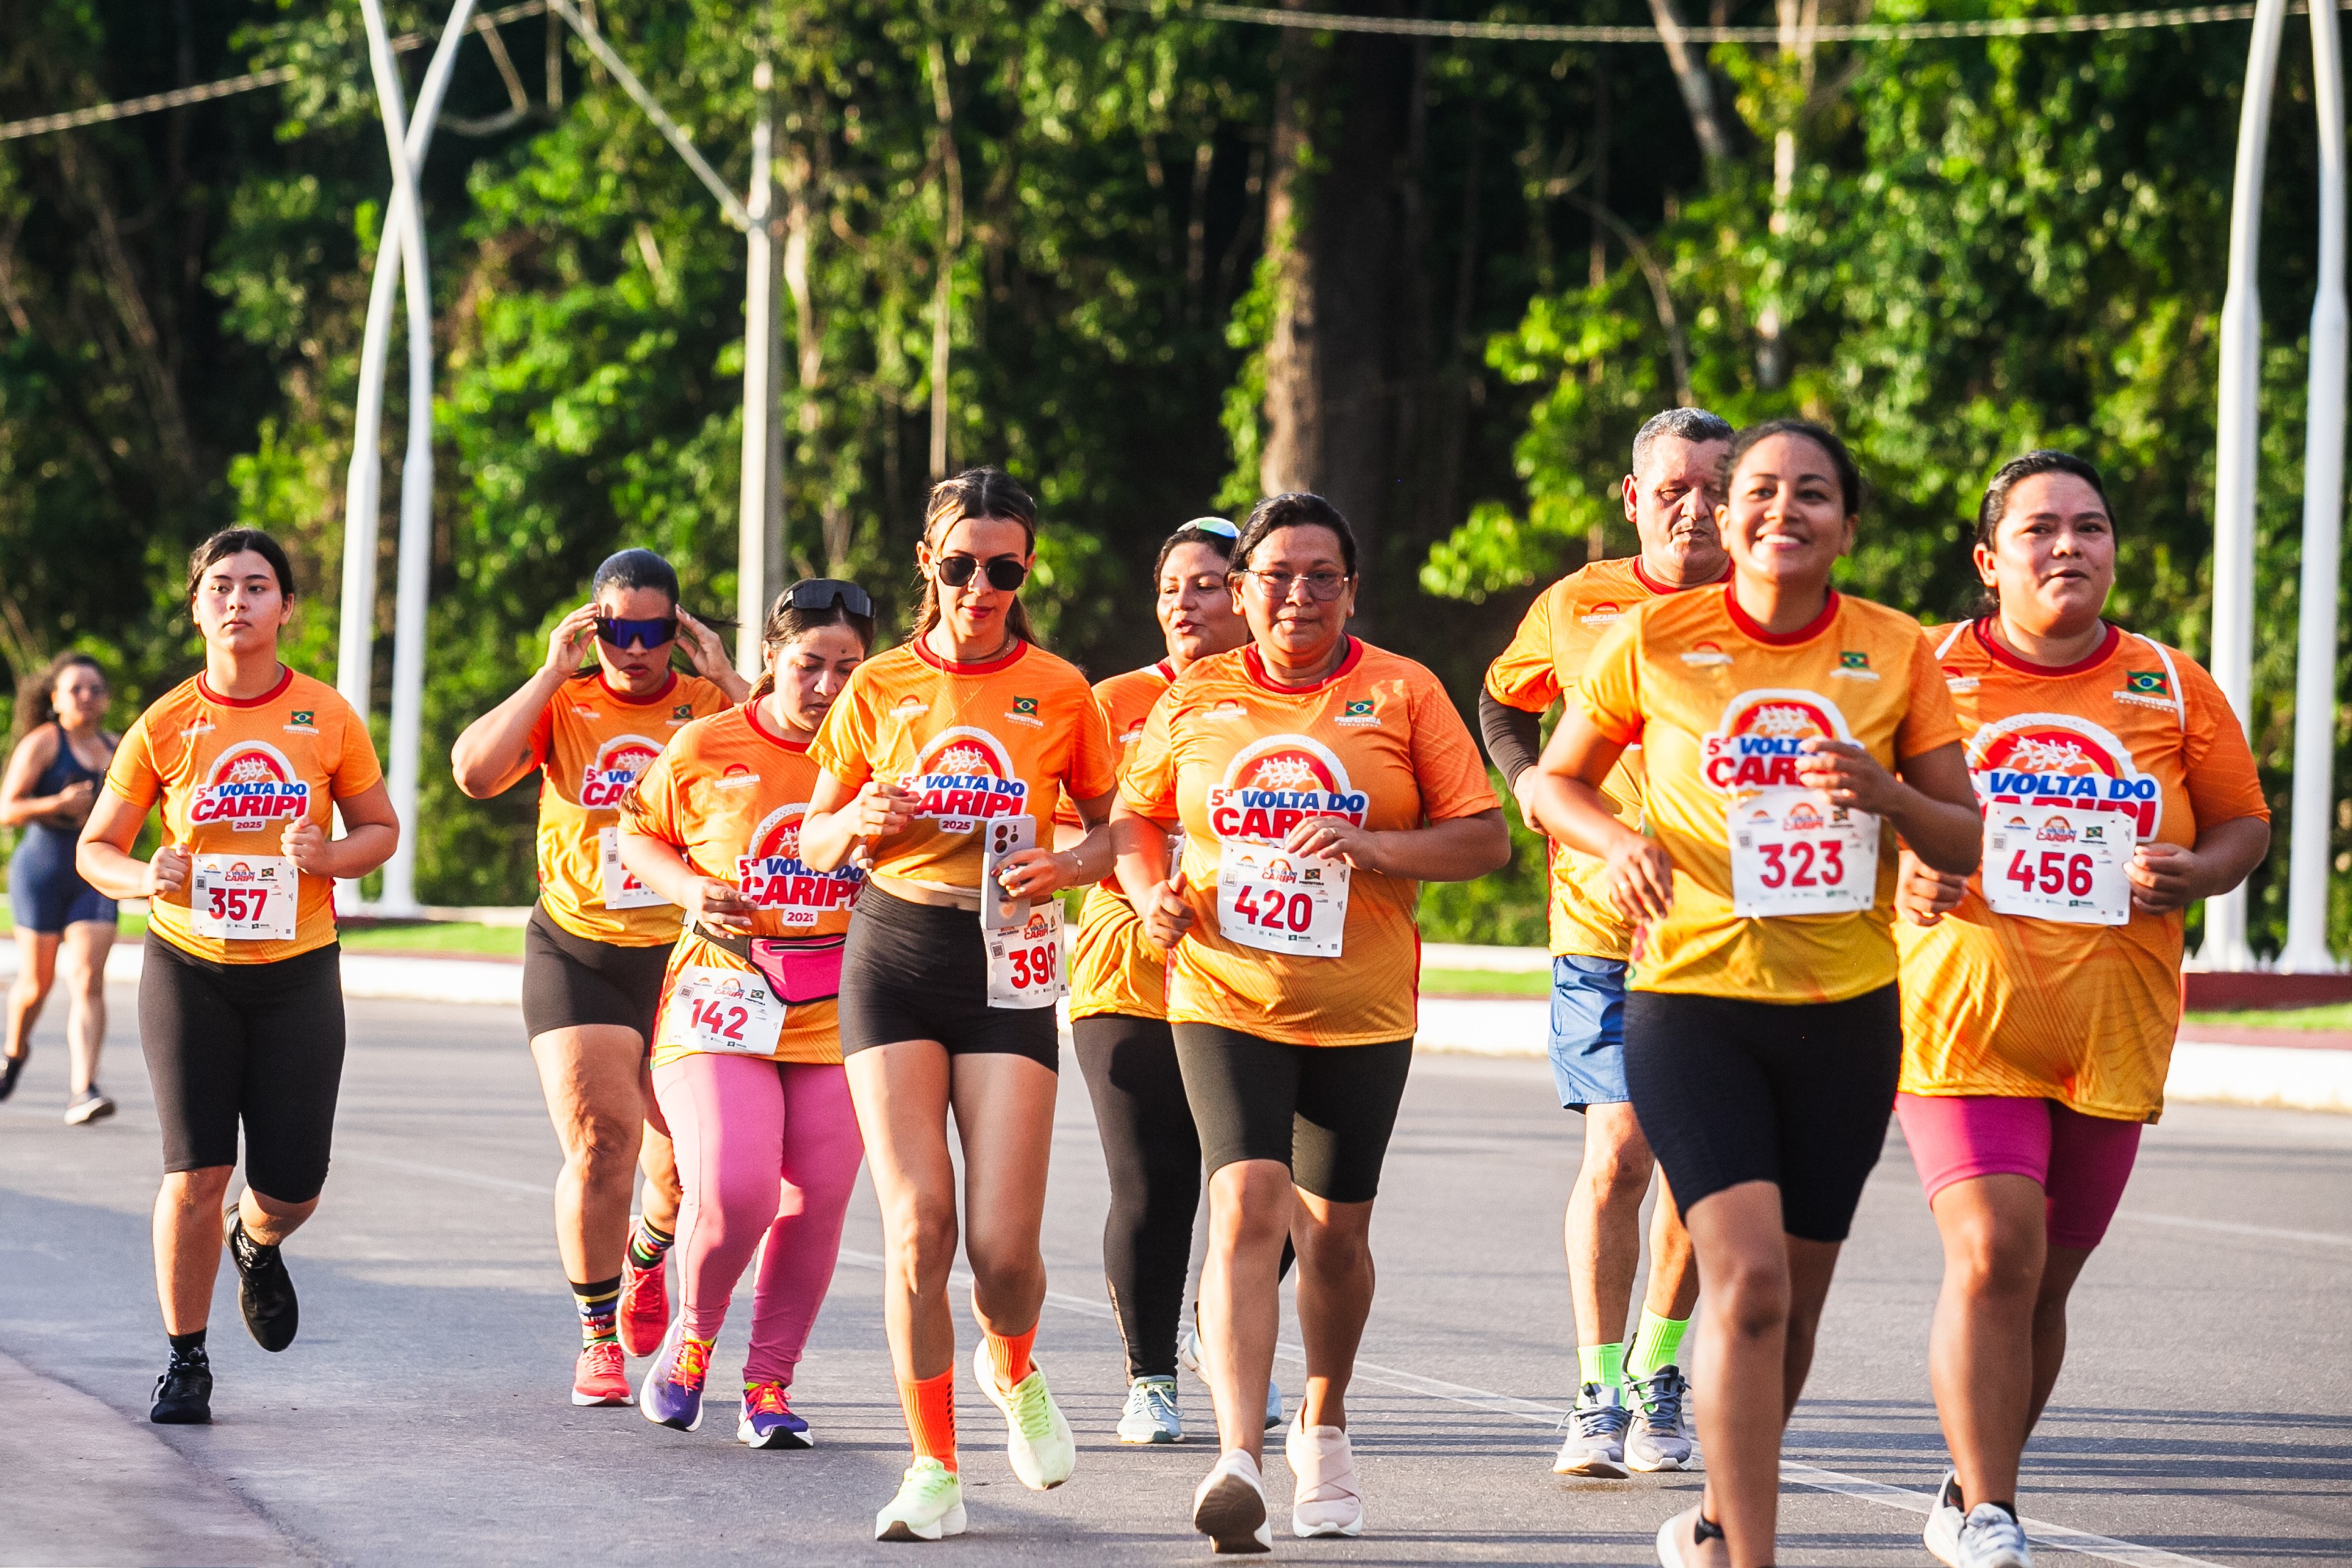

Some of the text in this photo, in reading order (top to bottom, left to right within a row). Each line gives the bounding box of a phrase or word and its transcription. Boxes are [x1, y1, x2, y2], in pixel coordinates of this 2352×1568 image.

[1004, 712, 1044, 726] PREFEITURA
[1334, 716, 1382, 725] PREFEITURA
[1739, 738, 1818, 756] VOLT
[219, 783, 276, 797] VOLTA
[280, 783, 307, 795] DO
[926, 775, 990, 791] VOLTA
[995, 780, 1025, 796] DO
[1990, 772, 2098, 798] VOLTA
[2109, 778, 2156, 800] DO
[191, 795, 307, 822] CARIPI
[909, 789, 1024, 818] ARIPI
[1241, 790, 1320, 810] VOLTA
[1327, 793, 1365, 812] DO
[235, 821, 263, 830] 2025
[941, 820, 971, 830] 2025
[1759, 840, 1844, 889] 323
[2006, 849, 2093, 896] 456
[208, 887, 267, 921] 357
[1234, 885, 1313, 933] 420
[1009, 941, 1056, 989] 398
[691, 999, 748, 1041] 142
